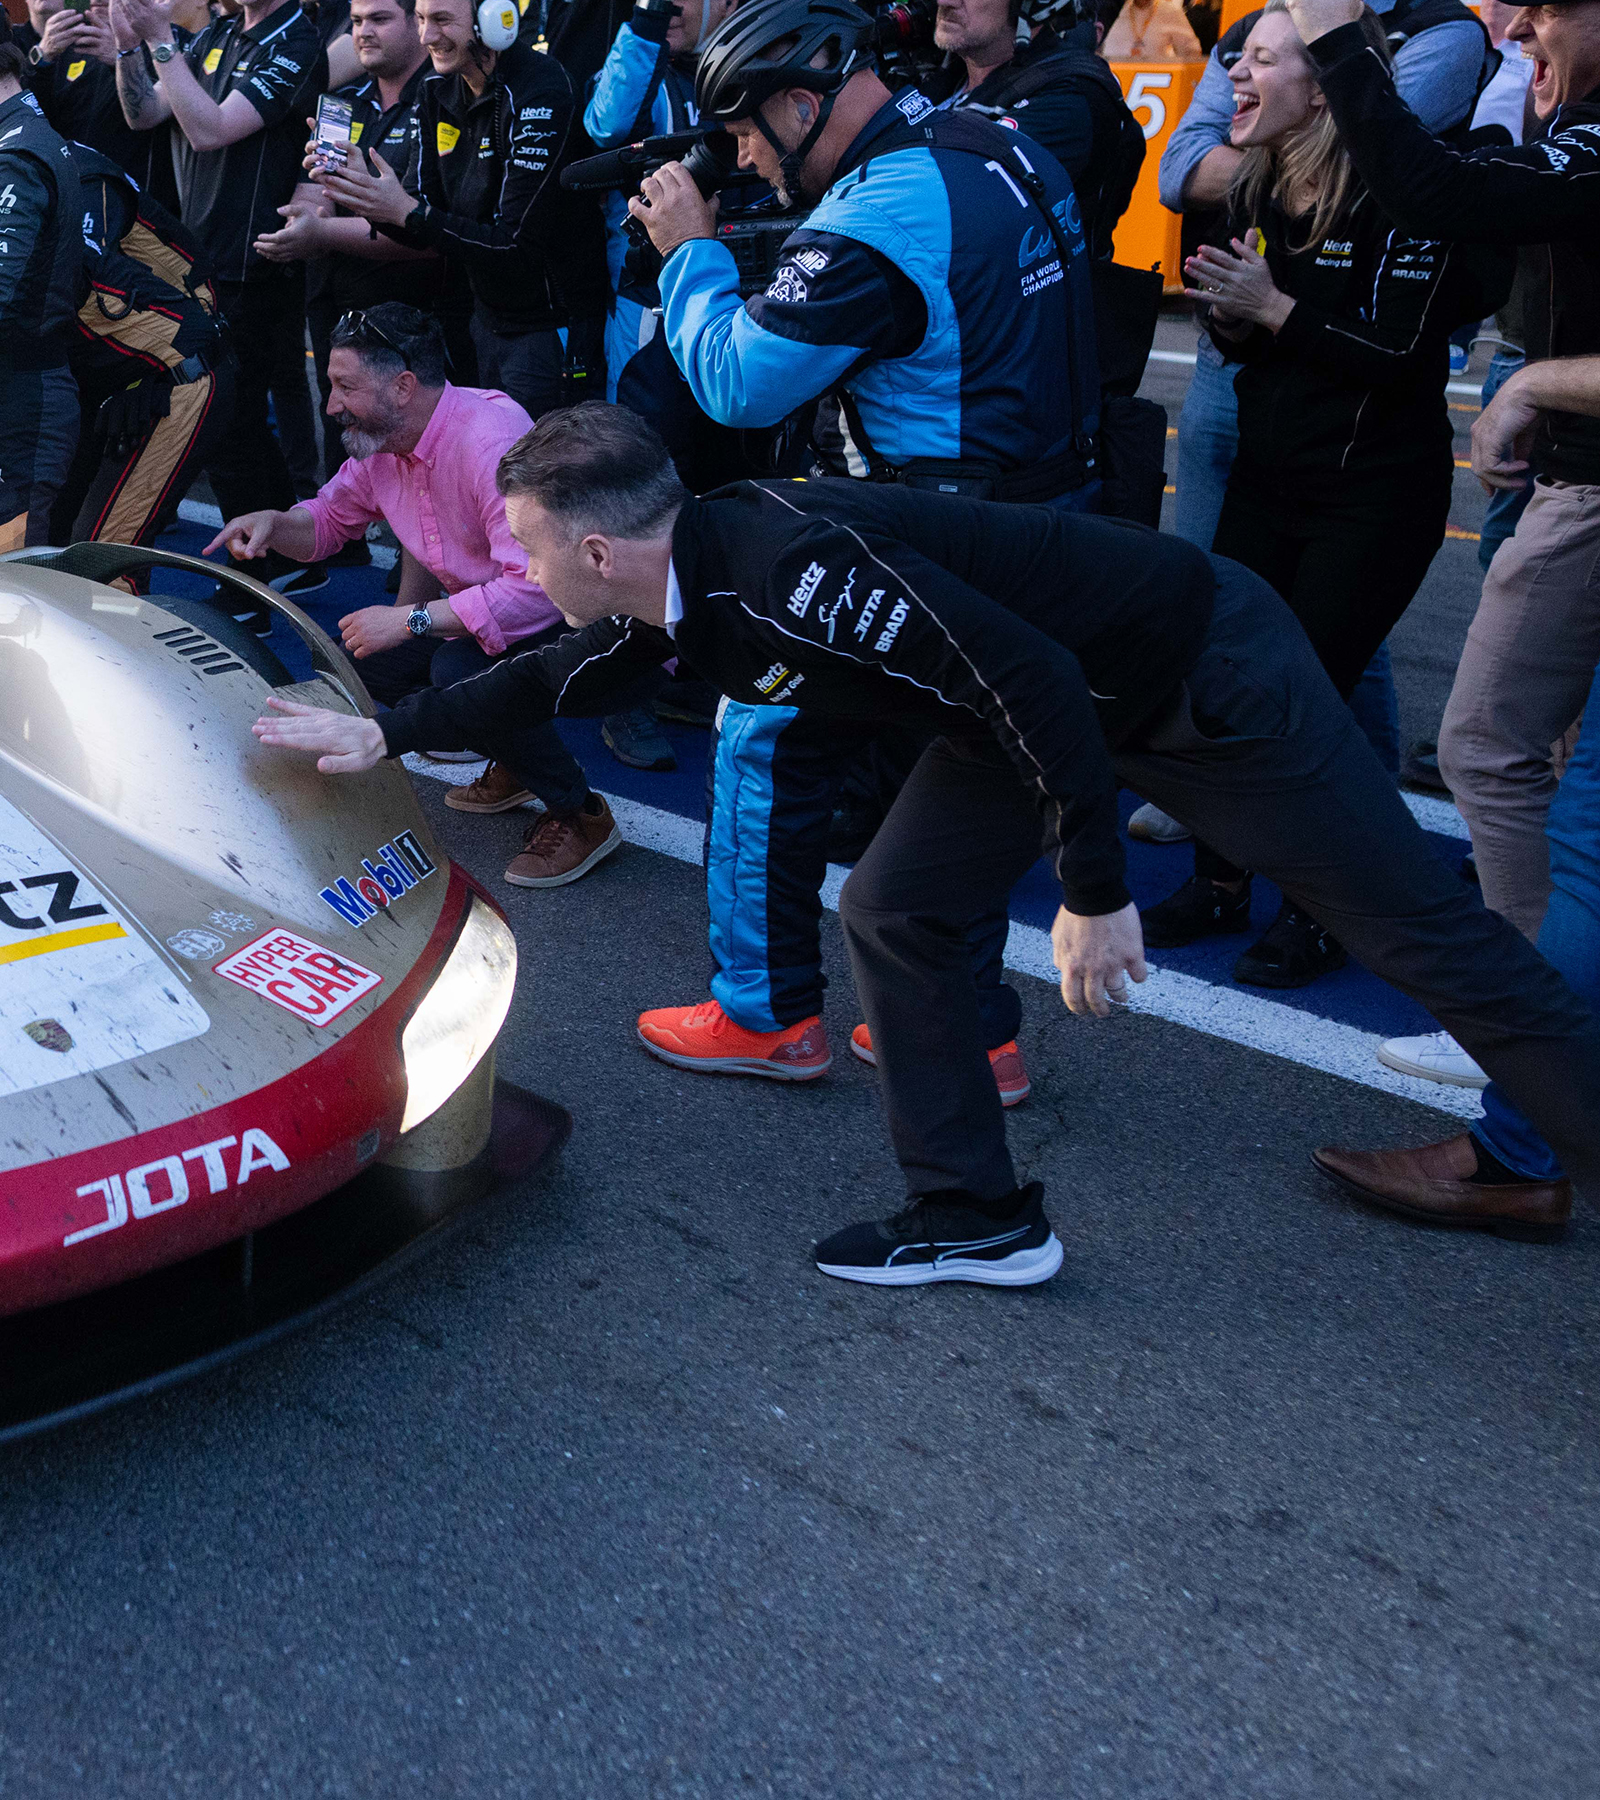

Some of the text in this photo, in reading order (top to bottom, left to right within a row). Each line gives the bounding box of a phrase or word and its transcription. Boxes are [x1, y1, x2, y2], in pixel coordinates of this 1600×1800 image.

[272, 54, 302, 74] Hertz
[520, 107, 553, 120] Hertz
[1113, 72, 1173, 140] 5
[513, 158, 547, 171] BRADY
[517, 146, 549, 156] JOTA
[771, 223, 798, 231] SONY
[792, 247, 830, 274] OMP
[1391, 269, 1432, 280] BRADY
[1021, 272, 1036, 287] FIA
[786, 561, 827, 619] Hertz
[853, 588, 887, 643] JOTA
[874, 597, 911, 653] BRADY
[753, 662, 788, 693] Hertz
[317, 843, 419, 929] Mobil
[226, 936, 312, 988] HYPER
[266, 952, 371, 1015] CAR
[63, 1128, 292, 1248] JOTA
